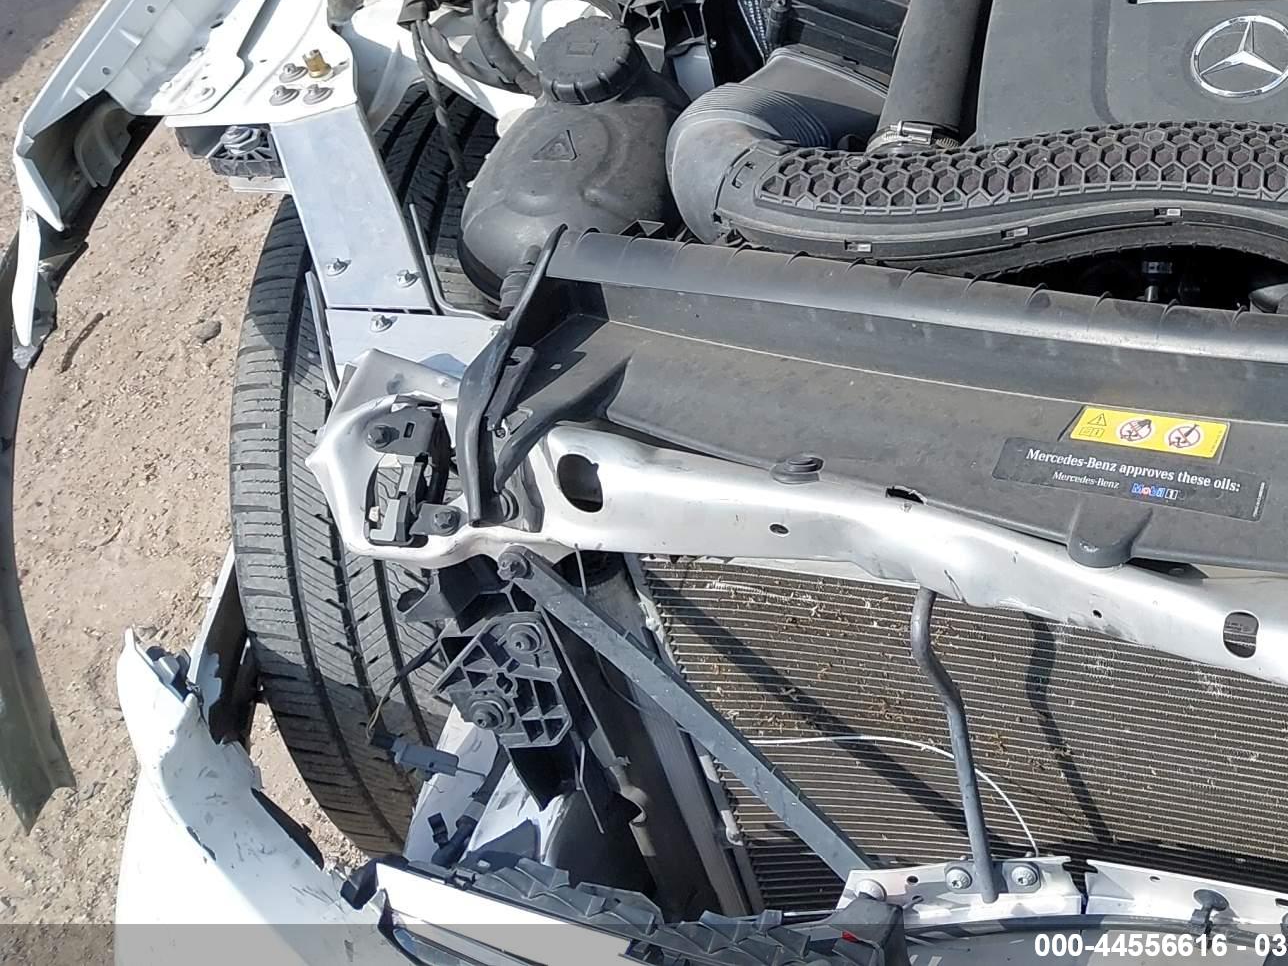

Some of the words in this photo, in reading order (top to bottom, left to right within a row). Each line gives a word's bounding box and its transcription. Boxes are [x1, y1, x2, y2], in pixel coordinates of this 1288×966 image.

[1026, 448, 1117, 471] Mercedes-Benz
[1119, 464, 1175, 481] approves
[1177, 471, 1211, 488] these
[1213, 477, 1241, 493] oils:
[1053, 471, 1120, 489] Mercedes-Benz
[1131, 483, 1166, 498] Mobil
